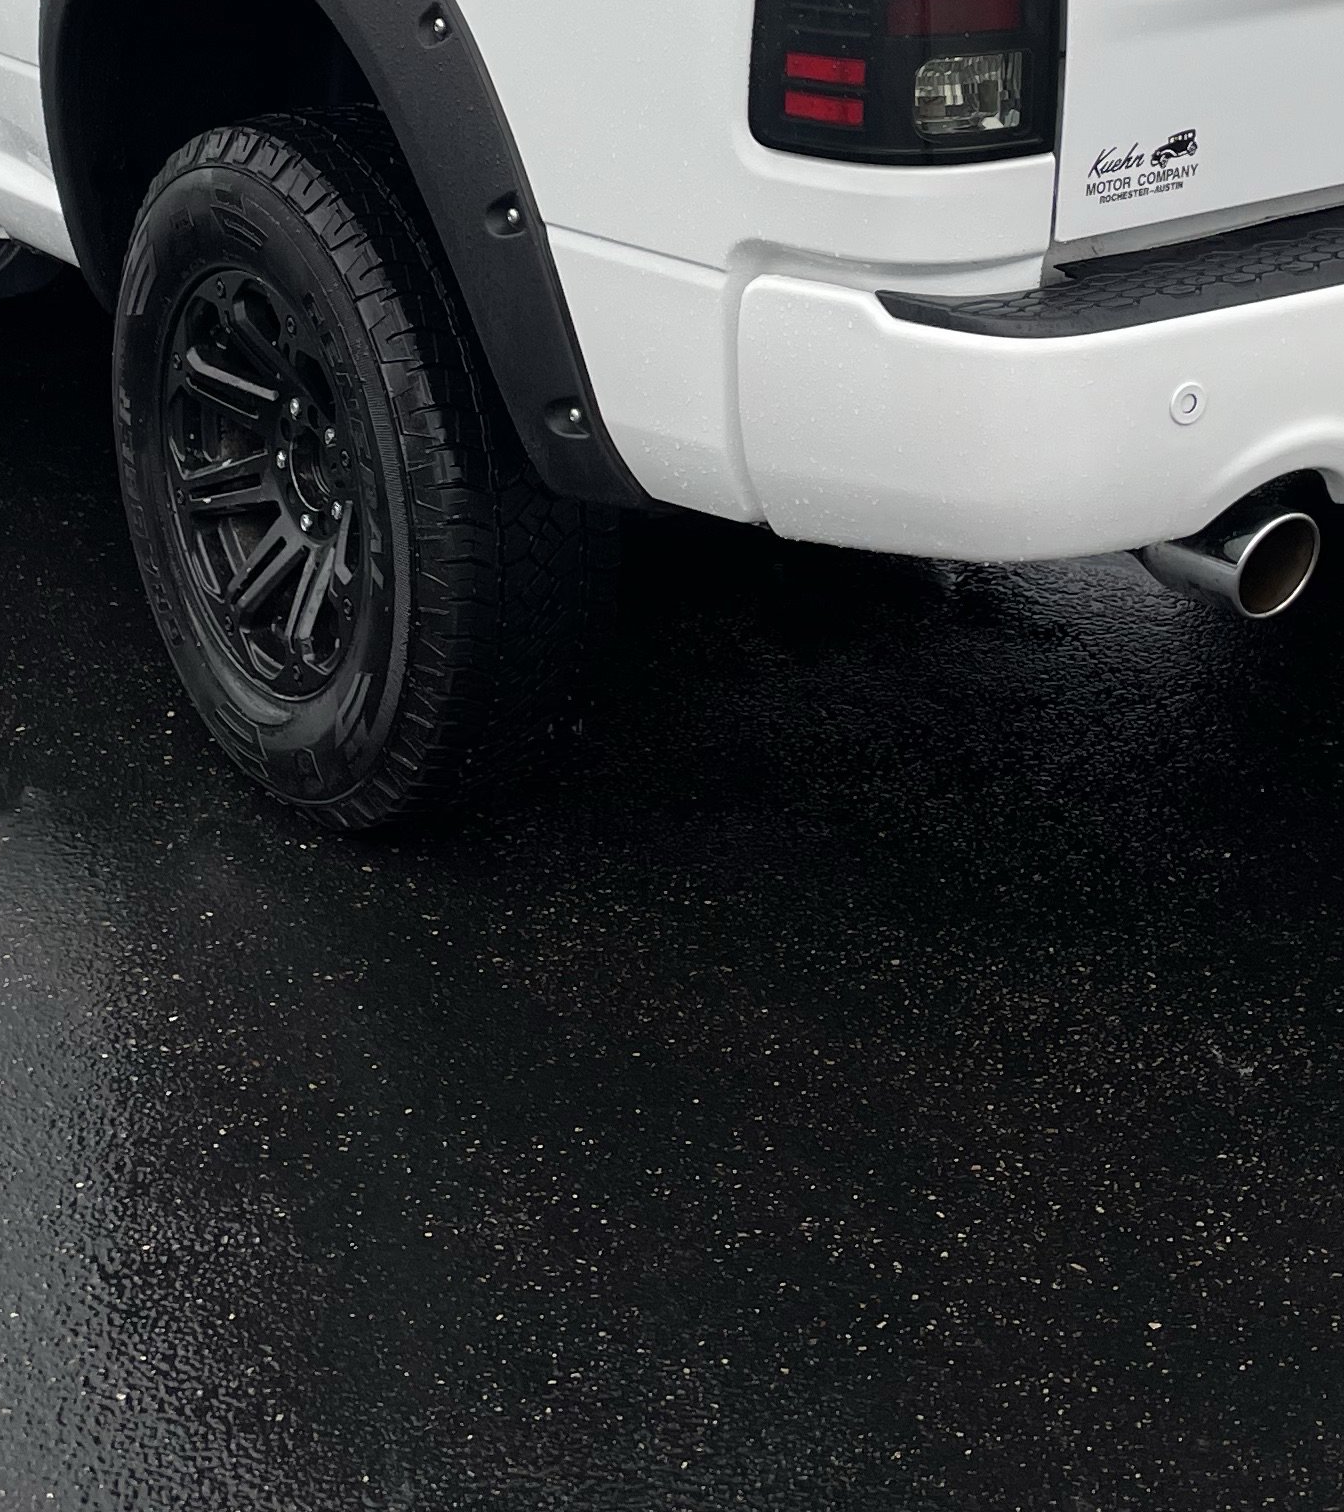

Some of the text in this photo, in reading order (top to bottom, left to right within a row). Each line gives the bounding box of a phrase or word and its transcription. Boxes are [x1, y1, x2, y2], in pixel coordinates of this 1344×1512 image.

[1088, 142, 1145, 178] Kuehn
[1086, 163, 1199, 197] MOTOR COMPANY
